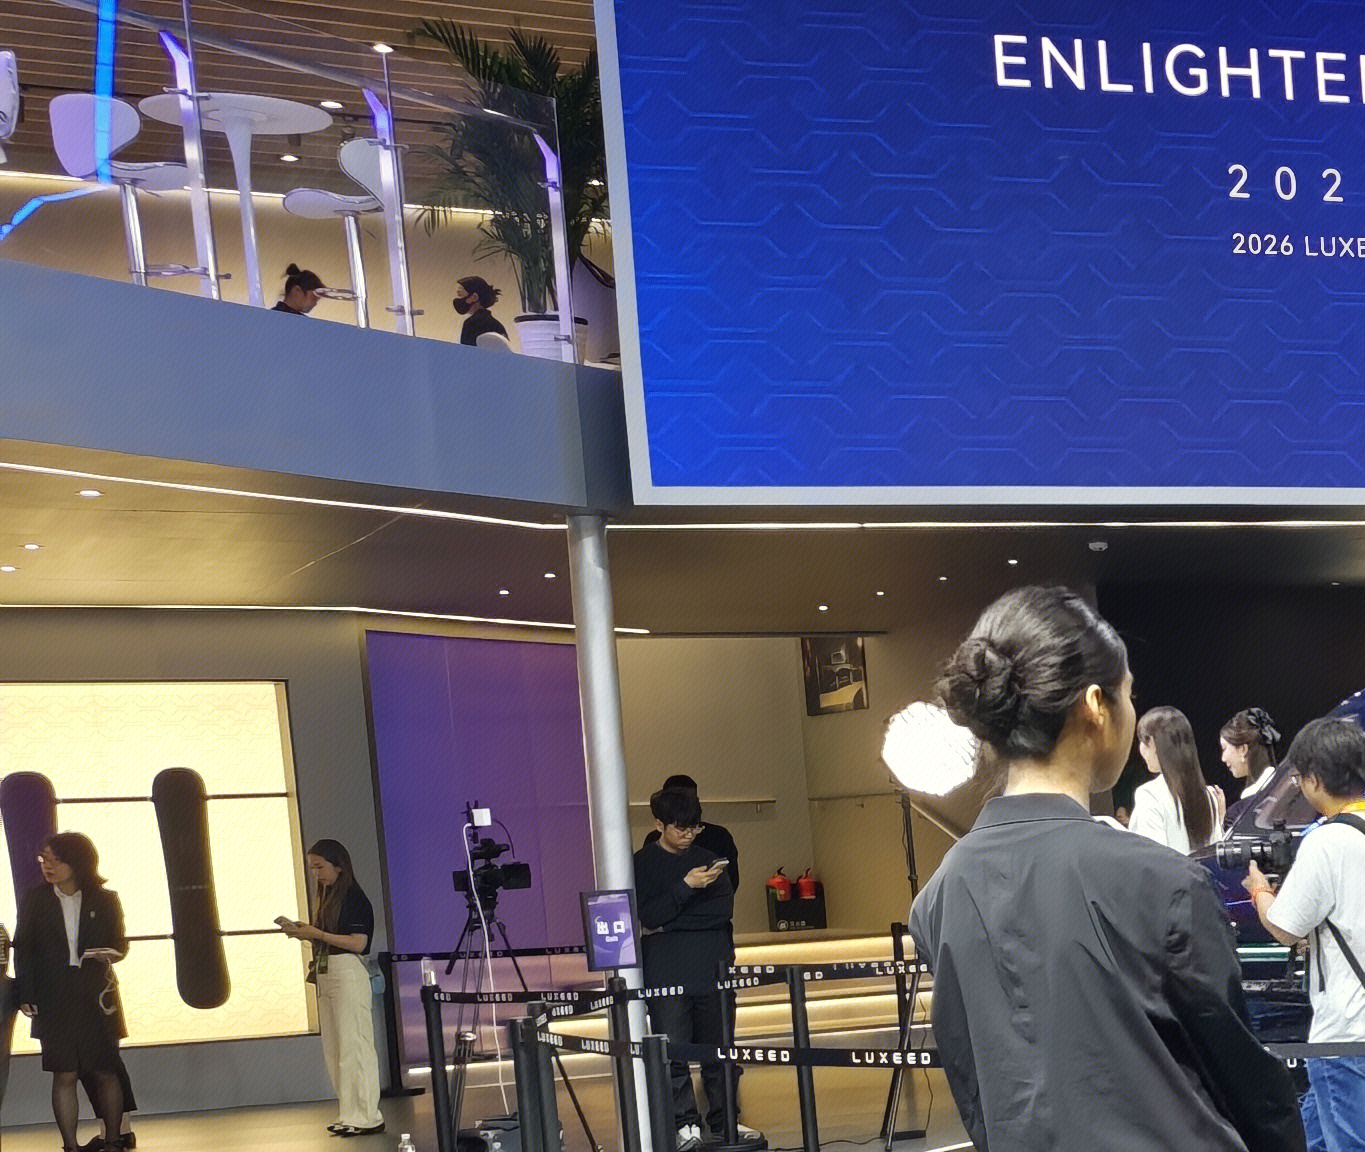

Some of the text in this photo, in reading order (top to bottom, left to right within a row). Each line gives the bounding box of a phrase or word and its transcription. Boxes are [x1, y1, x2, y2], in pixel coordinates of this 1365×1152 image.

[1232, 232, 1294, 256] 2026
[728, 965, 775, 975] XEED
[876, 963, 928, 976] LUXEE
[637, 985, 684, 999] LUXEED
[717, 1047, 931, 1065] LUXEED LUXEED
